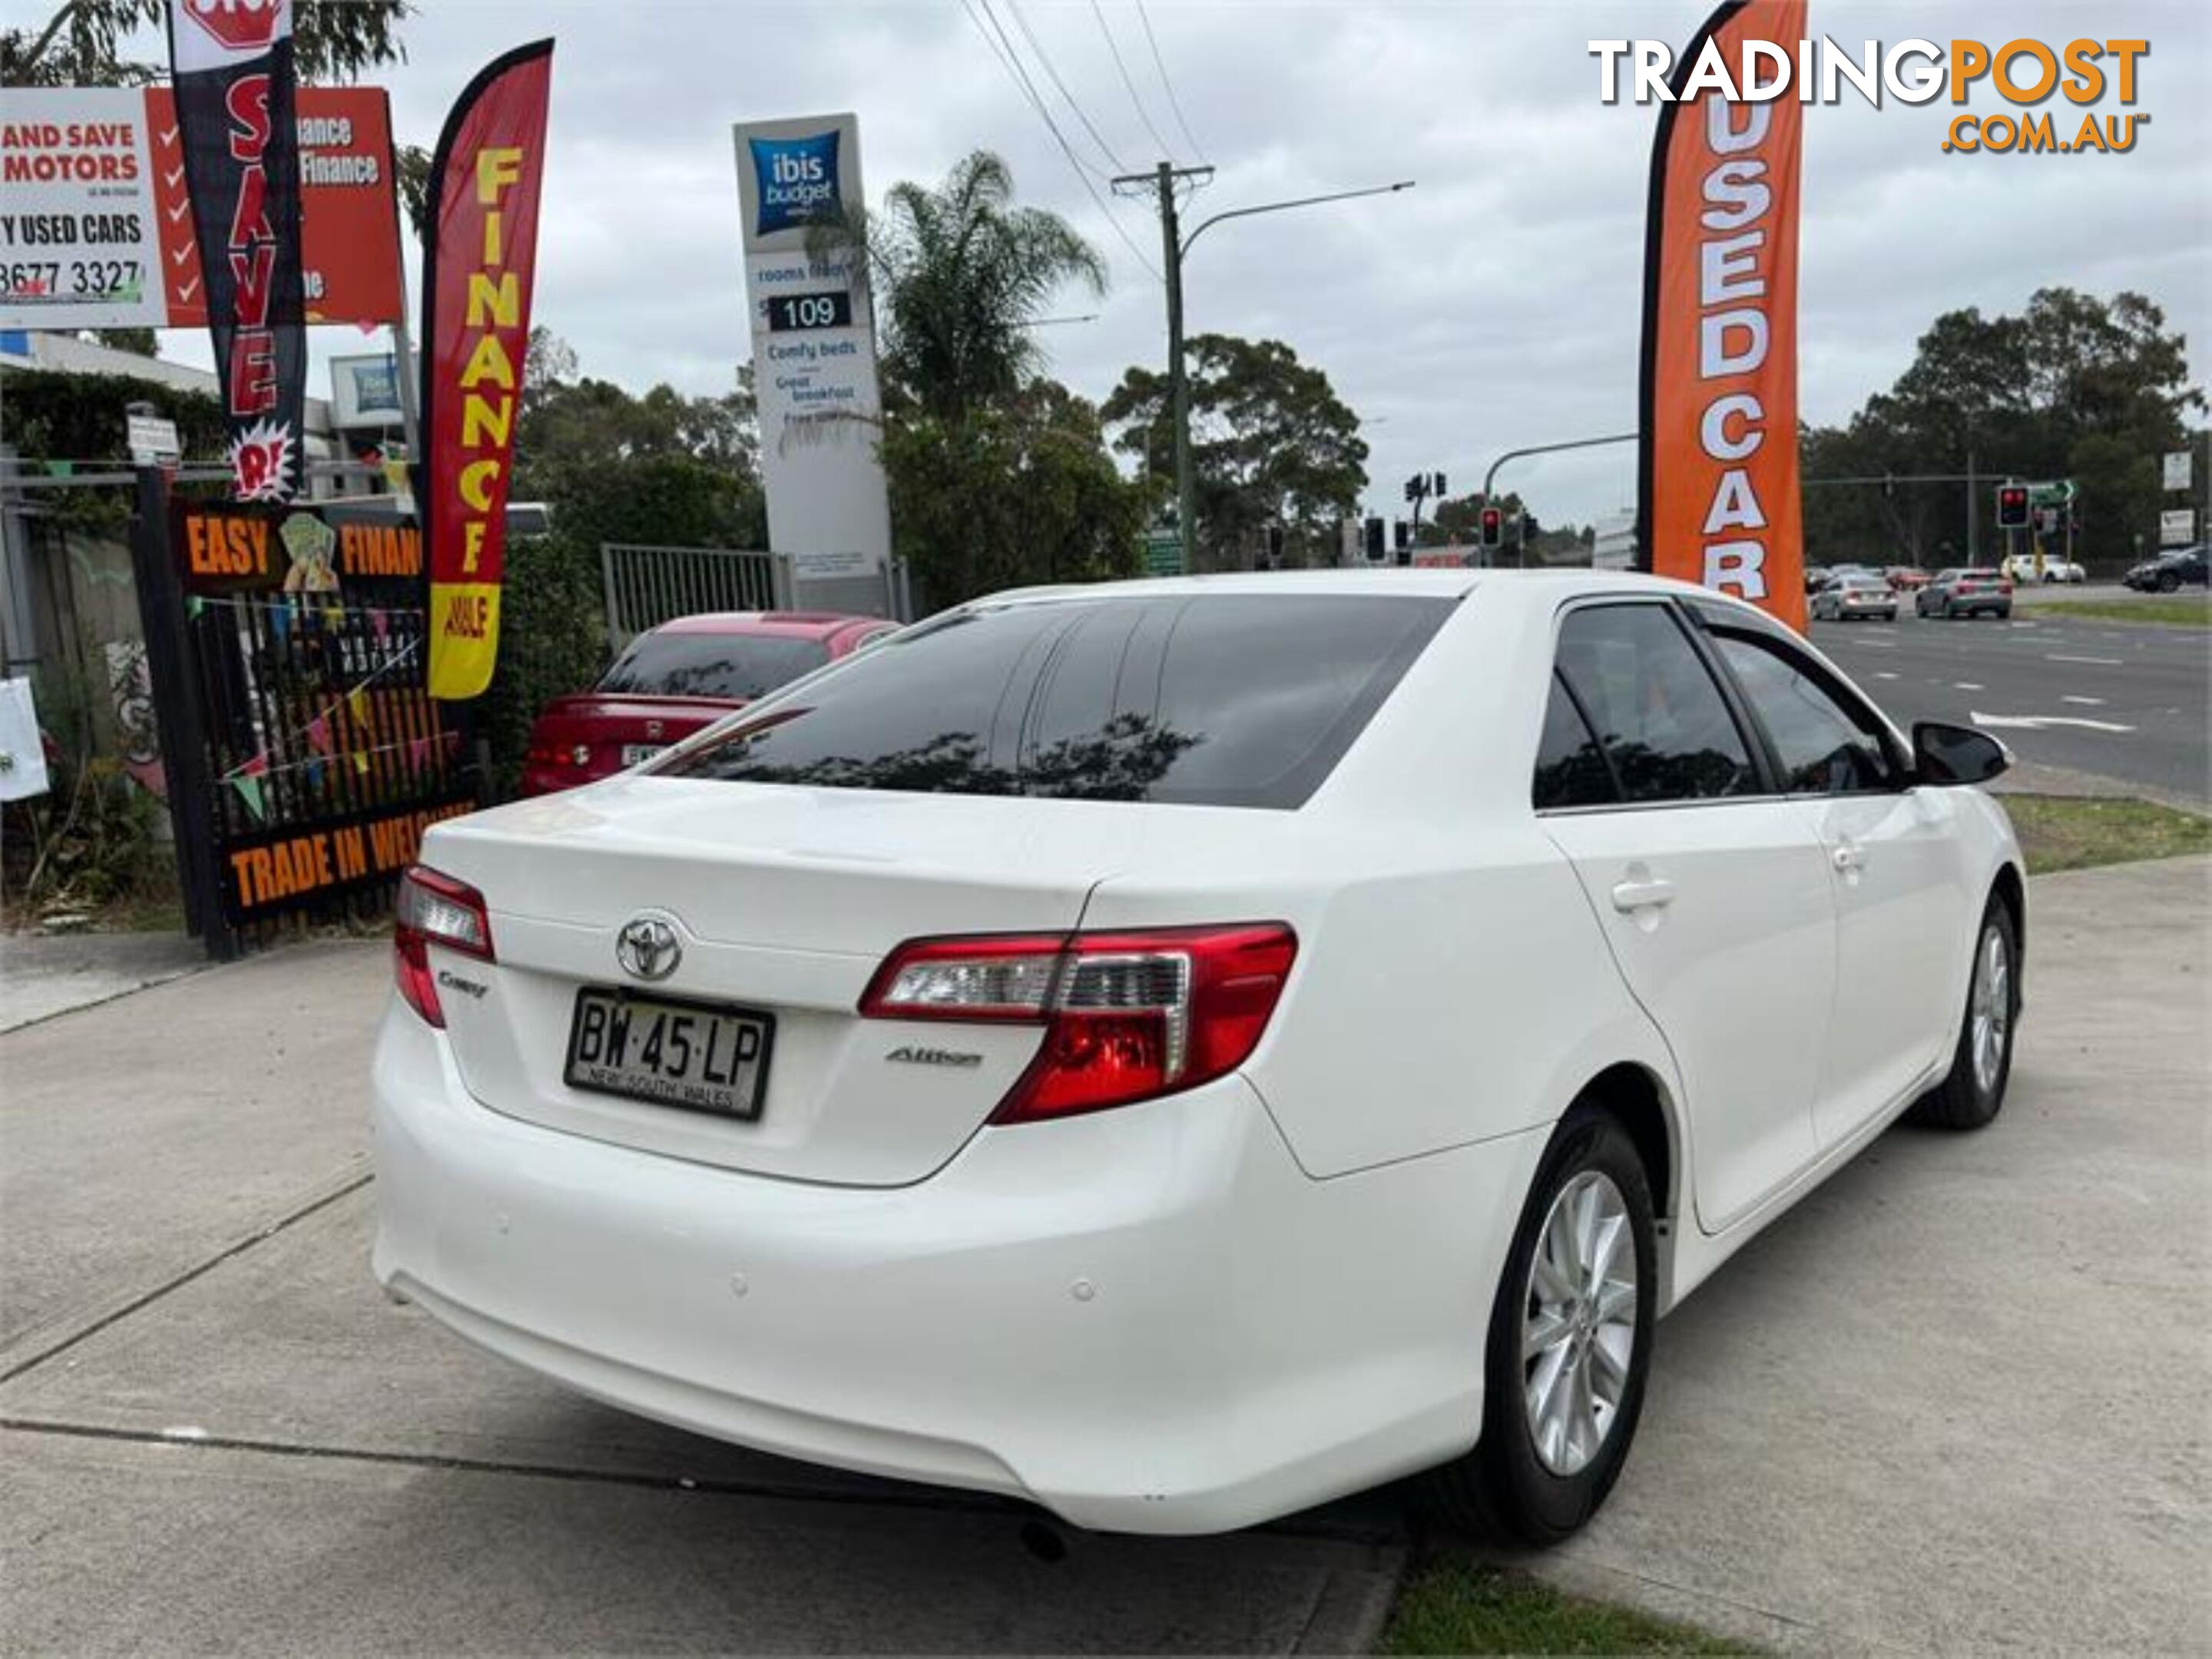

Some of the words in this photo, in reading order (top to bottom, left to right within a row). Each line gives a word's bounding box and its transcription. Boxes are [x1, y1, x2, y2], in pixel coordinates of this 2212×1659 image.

[2, 124, 61, 148] AND
[66, 124, 134, 147] SAVE
[4, 154, 139, 182] MOTORS
[298, 151, 379, 184] Finance
[773, 151, 824, 184] ibis
[767, 180, 832, 206] budget
[20, 214, 77, 245] USED
[81, 214, 141, 244] CARS
[1700, 78, 1771, 378] USED
[226, 74, 276, 416] SAVE
[71, 261, 139, 293] 3327
[783, 297, 836, 328] 109
[768, 343, 816, 362] Comfy
[819, 341, 857, 356] beds
[186, 515, 268, 575] EASY
[341, 525, 422, 575] FINAN
[232, 834, 333, 908] TRADE
[333, 825, 367, 879] IN
[628, 1074, 677, 1097] SOUTH
[684, 1084, 733, 1108] WALES
